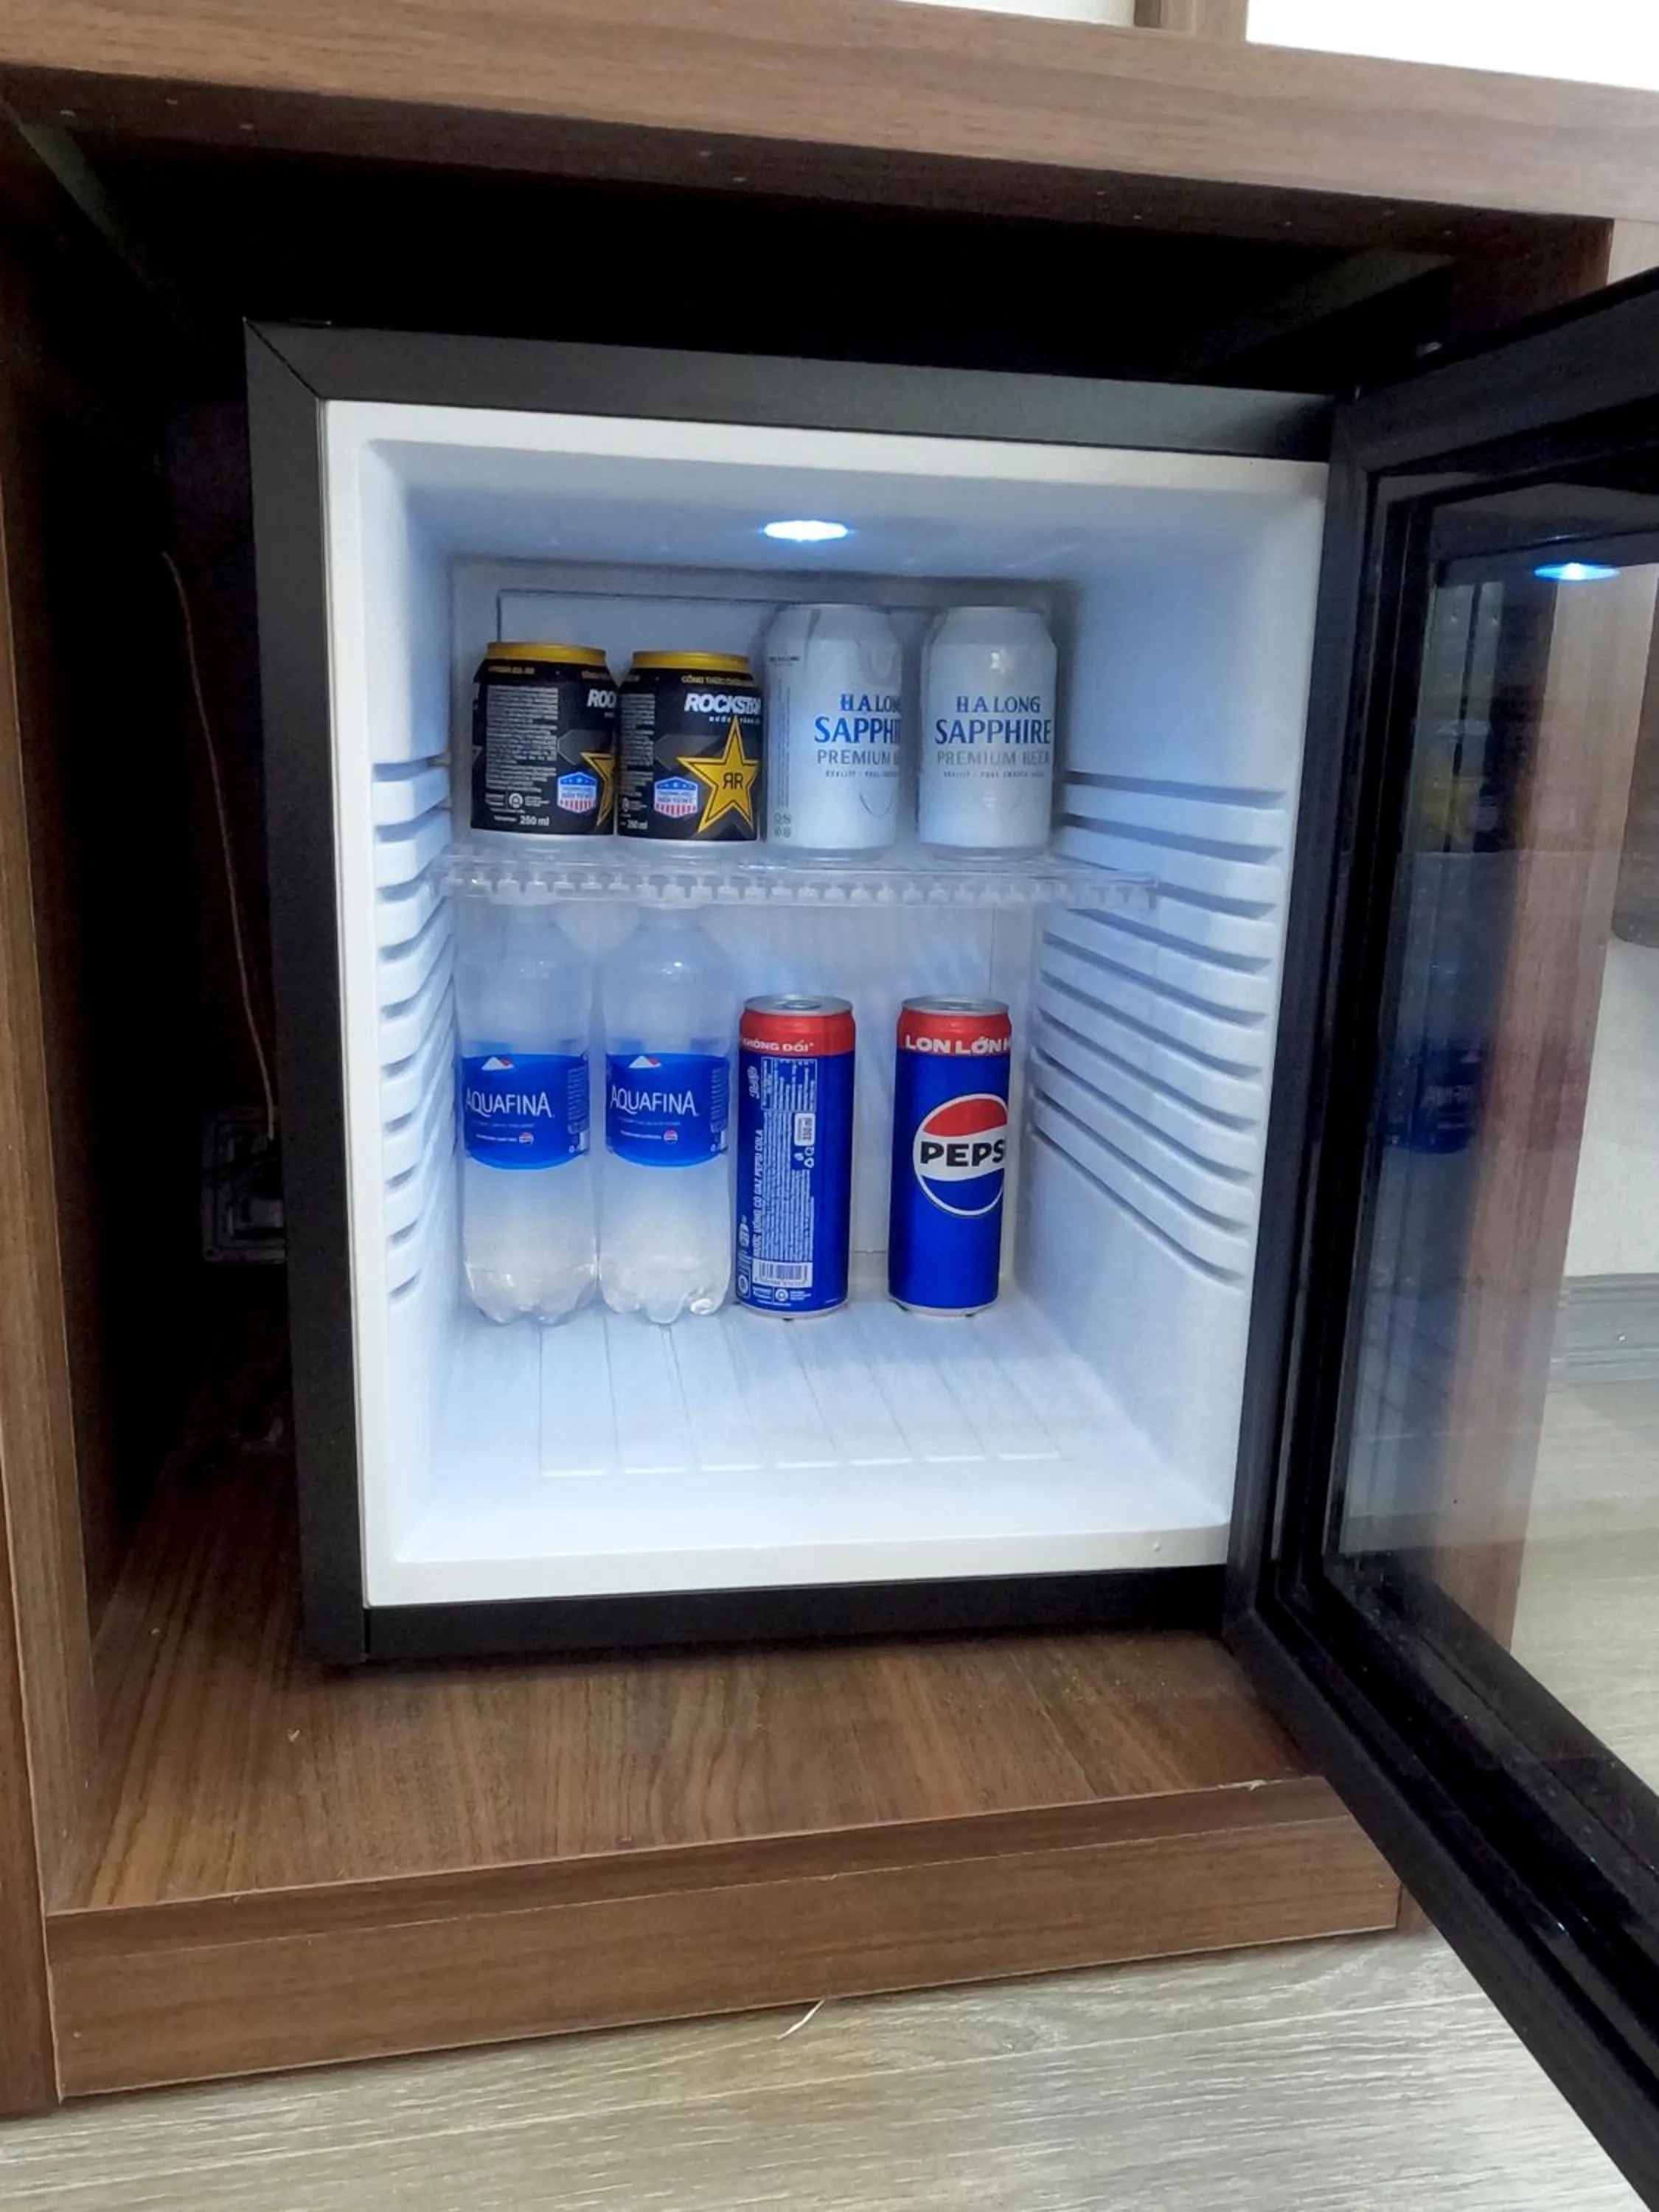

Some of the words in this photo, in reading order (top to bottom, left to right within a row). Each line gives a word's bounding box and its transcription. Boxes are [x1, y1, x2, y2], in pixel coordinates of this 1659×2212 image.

[814, 716, 901, 744] SAPPHI
[934, 719, 1052, 744] SAPPHIRE
[936, 751, 1017, 765] PREMIUM
[519, 815, 537, 825] 250
[538, 815, 549, 826] ml
[905, 1034, 951, 1054] LON
[955, 1032, 1002, 1054] LỚN
[465, 1088, 552, 1119] AQUAFINA
[610, 1085, 698, 1117] AQUAFINA
[920, 1139, 1005, 1166] PEPS
